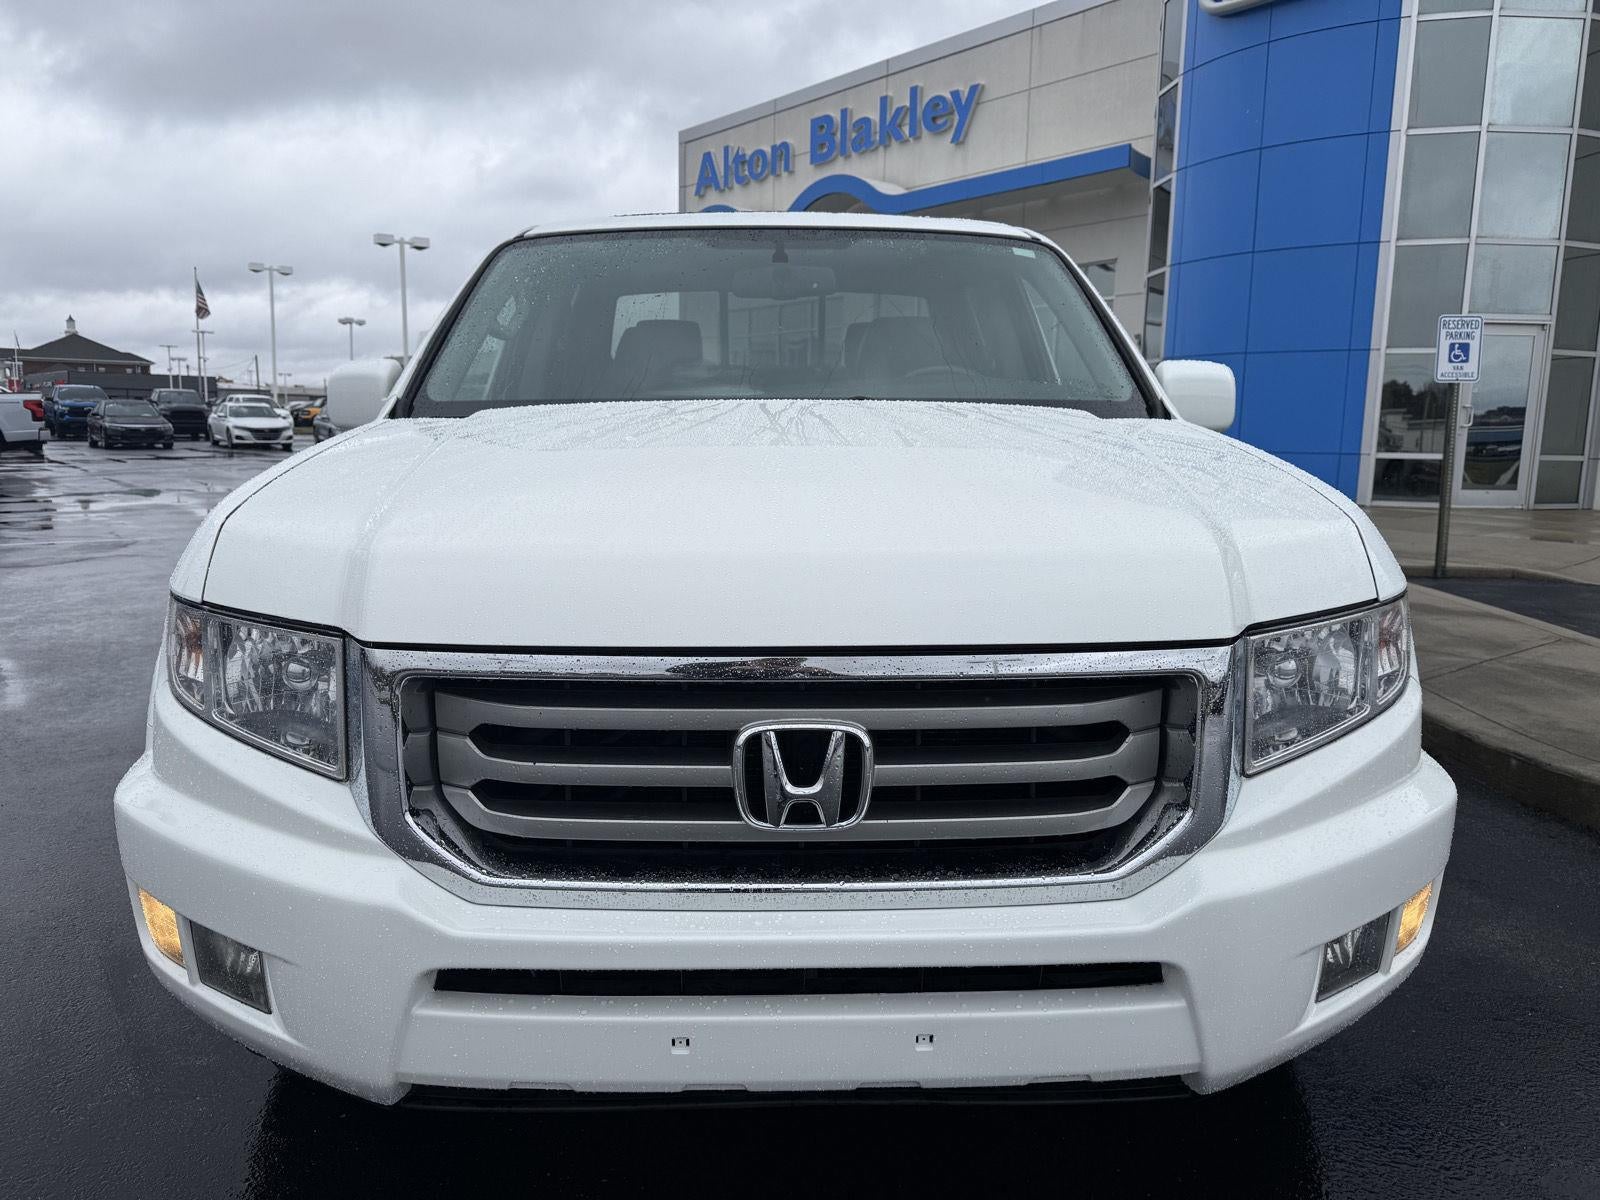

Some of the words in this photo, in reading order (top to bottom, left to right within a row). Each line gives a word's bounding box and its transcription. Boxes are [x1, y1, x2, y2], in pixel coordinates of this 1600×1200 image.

[694, 140, 794, 197] Alton
[809, 83, 984, 166] Blakley
[1442, 319, 1480, 330] RESERVED
[1445, 331, 1476, 340] PARKING
